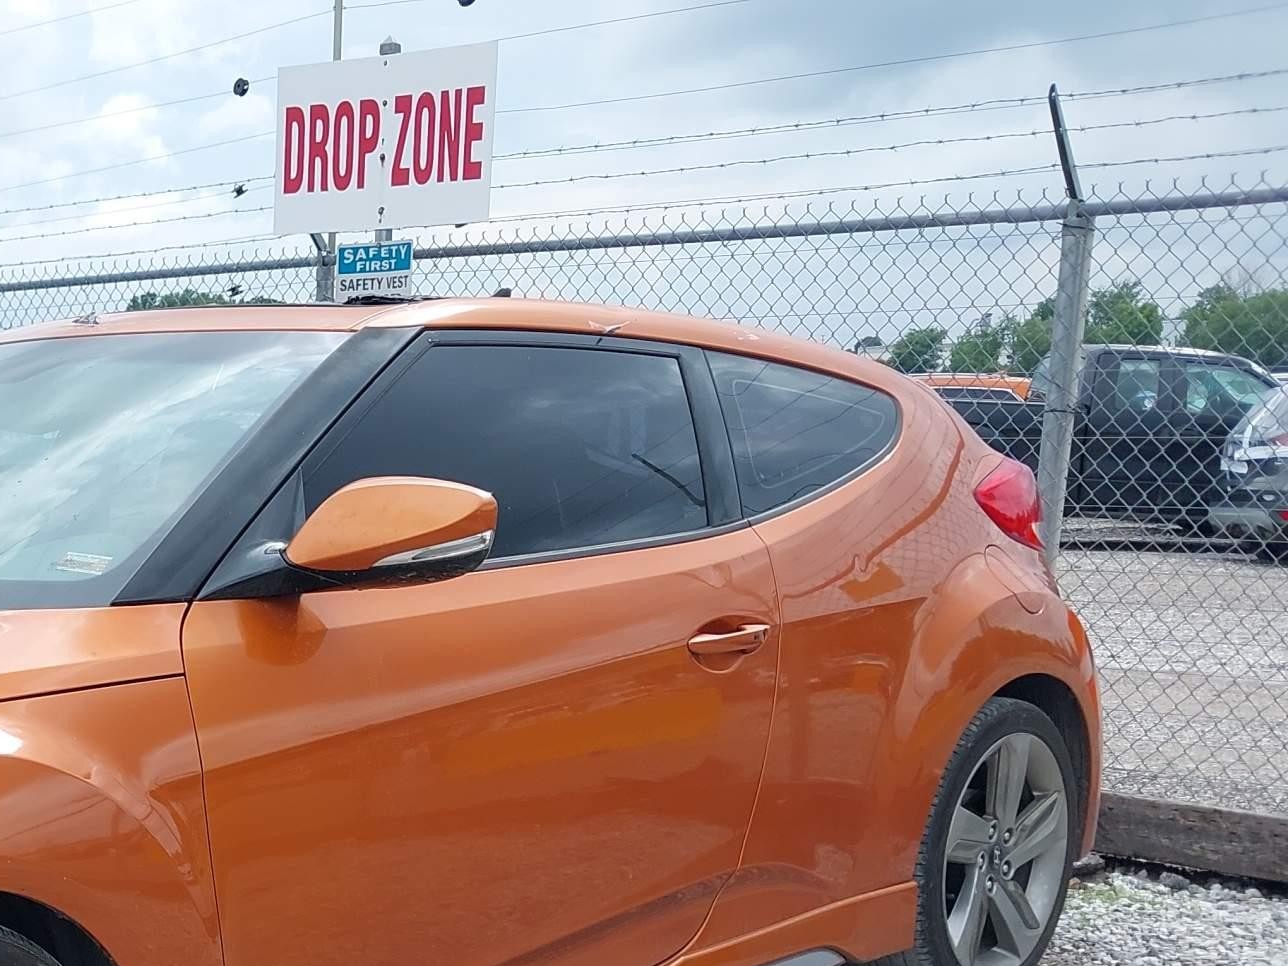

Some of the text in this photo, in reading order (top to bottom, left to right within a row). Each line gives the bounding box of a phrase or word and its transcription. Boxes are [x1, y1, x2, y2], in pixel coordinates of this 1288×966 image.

[283, 86, 486, 194] DROP ZONE
[343, 245, 408, 264] SAFETY
[356, 259, 397, 272] FIRST
[339, 275, 409, 292] SAFETY VEST
